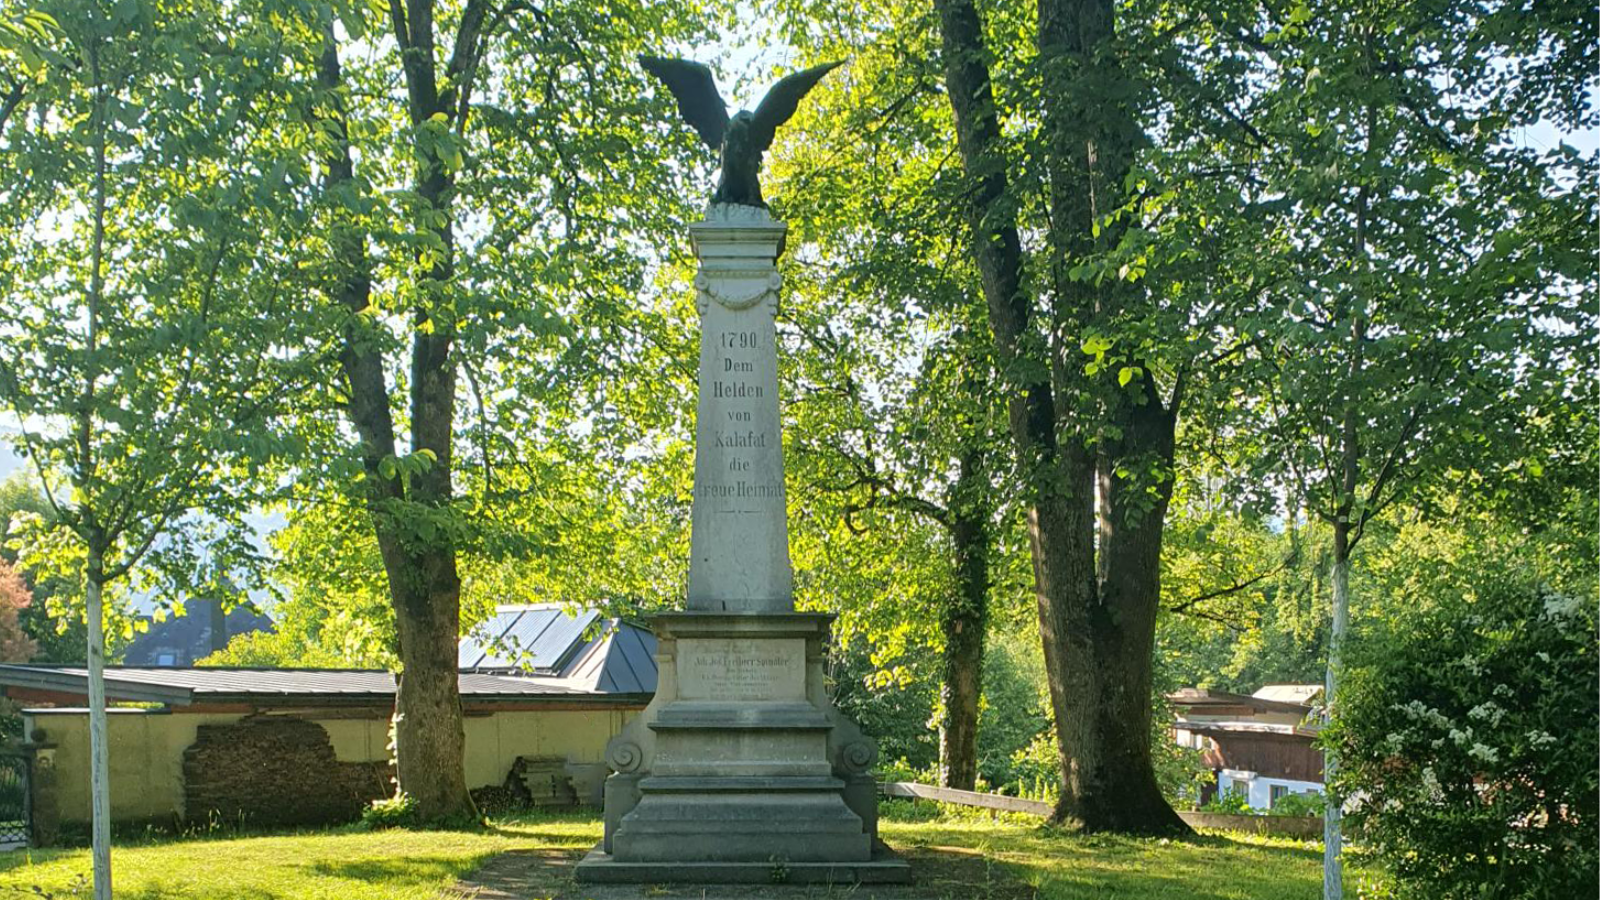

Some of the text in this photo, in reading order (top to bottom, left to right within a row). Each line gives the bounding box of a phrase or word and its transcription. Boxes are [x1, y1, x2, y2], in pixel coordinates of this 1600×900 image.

[722, 332, 757, 349] 1790
[724, 358, 753, 372] Dem
[713, 381, 764, 398] Helden
[728, 411, 751, 421] von
[714, 430, 766, 448] Kalafat
[729, 457, 750, 471] die
[737, 481, 783, 498] Heimat
